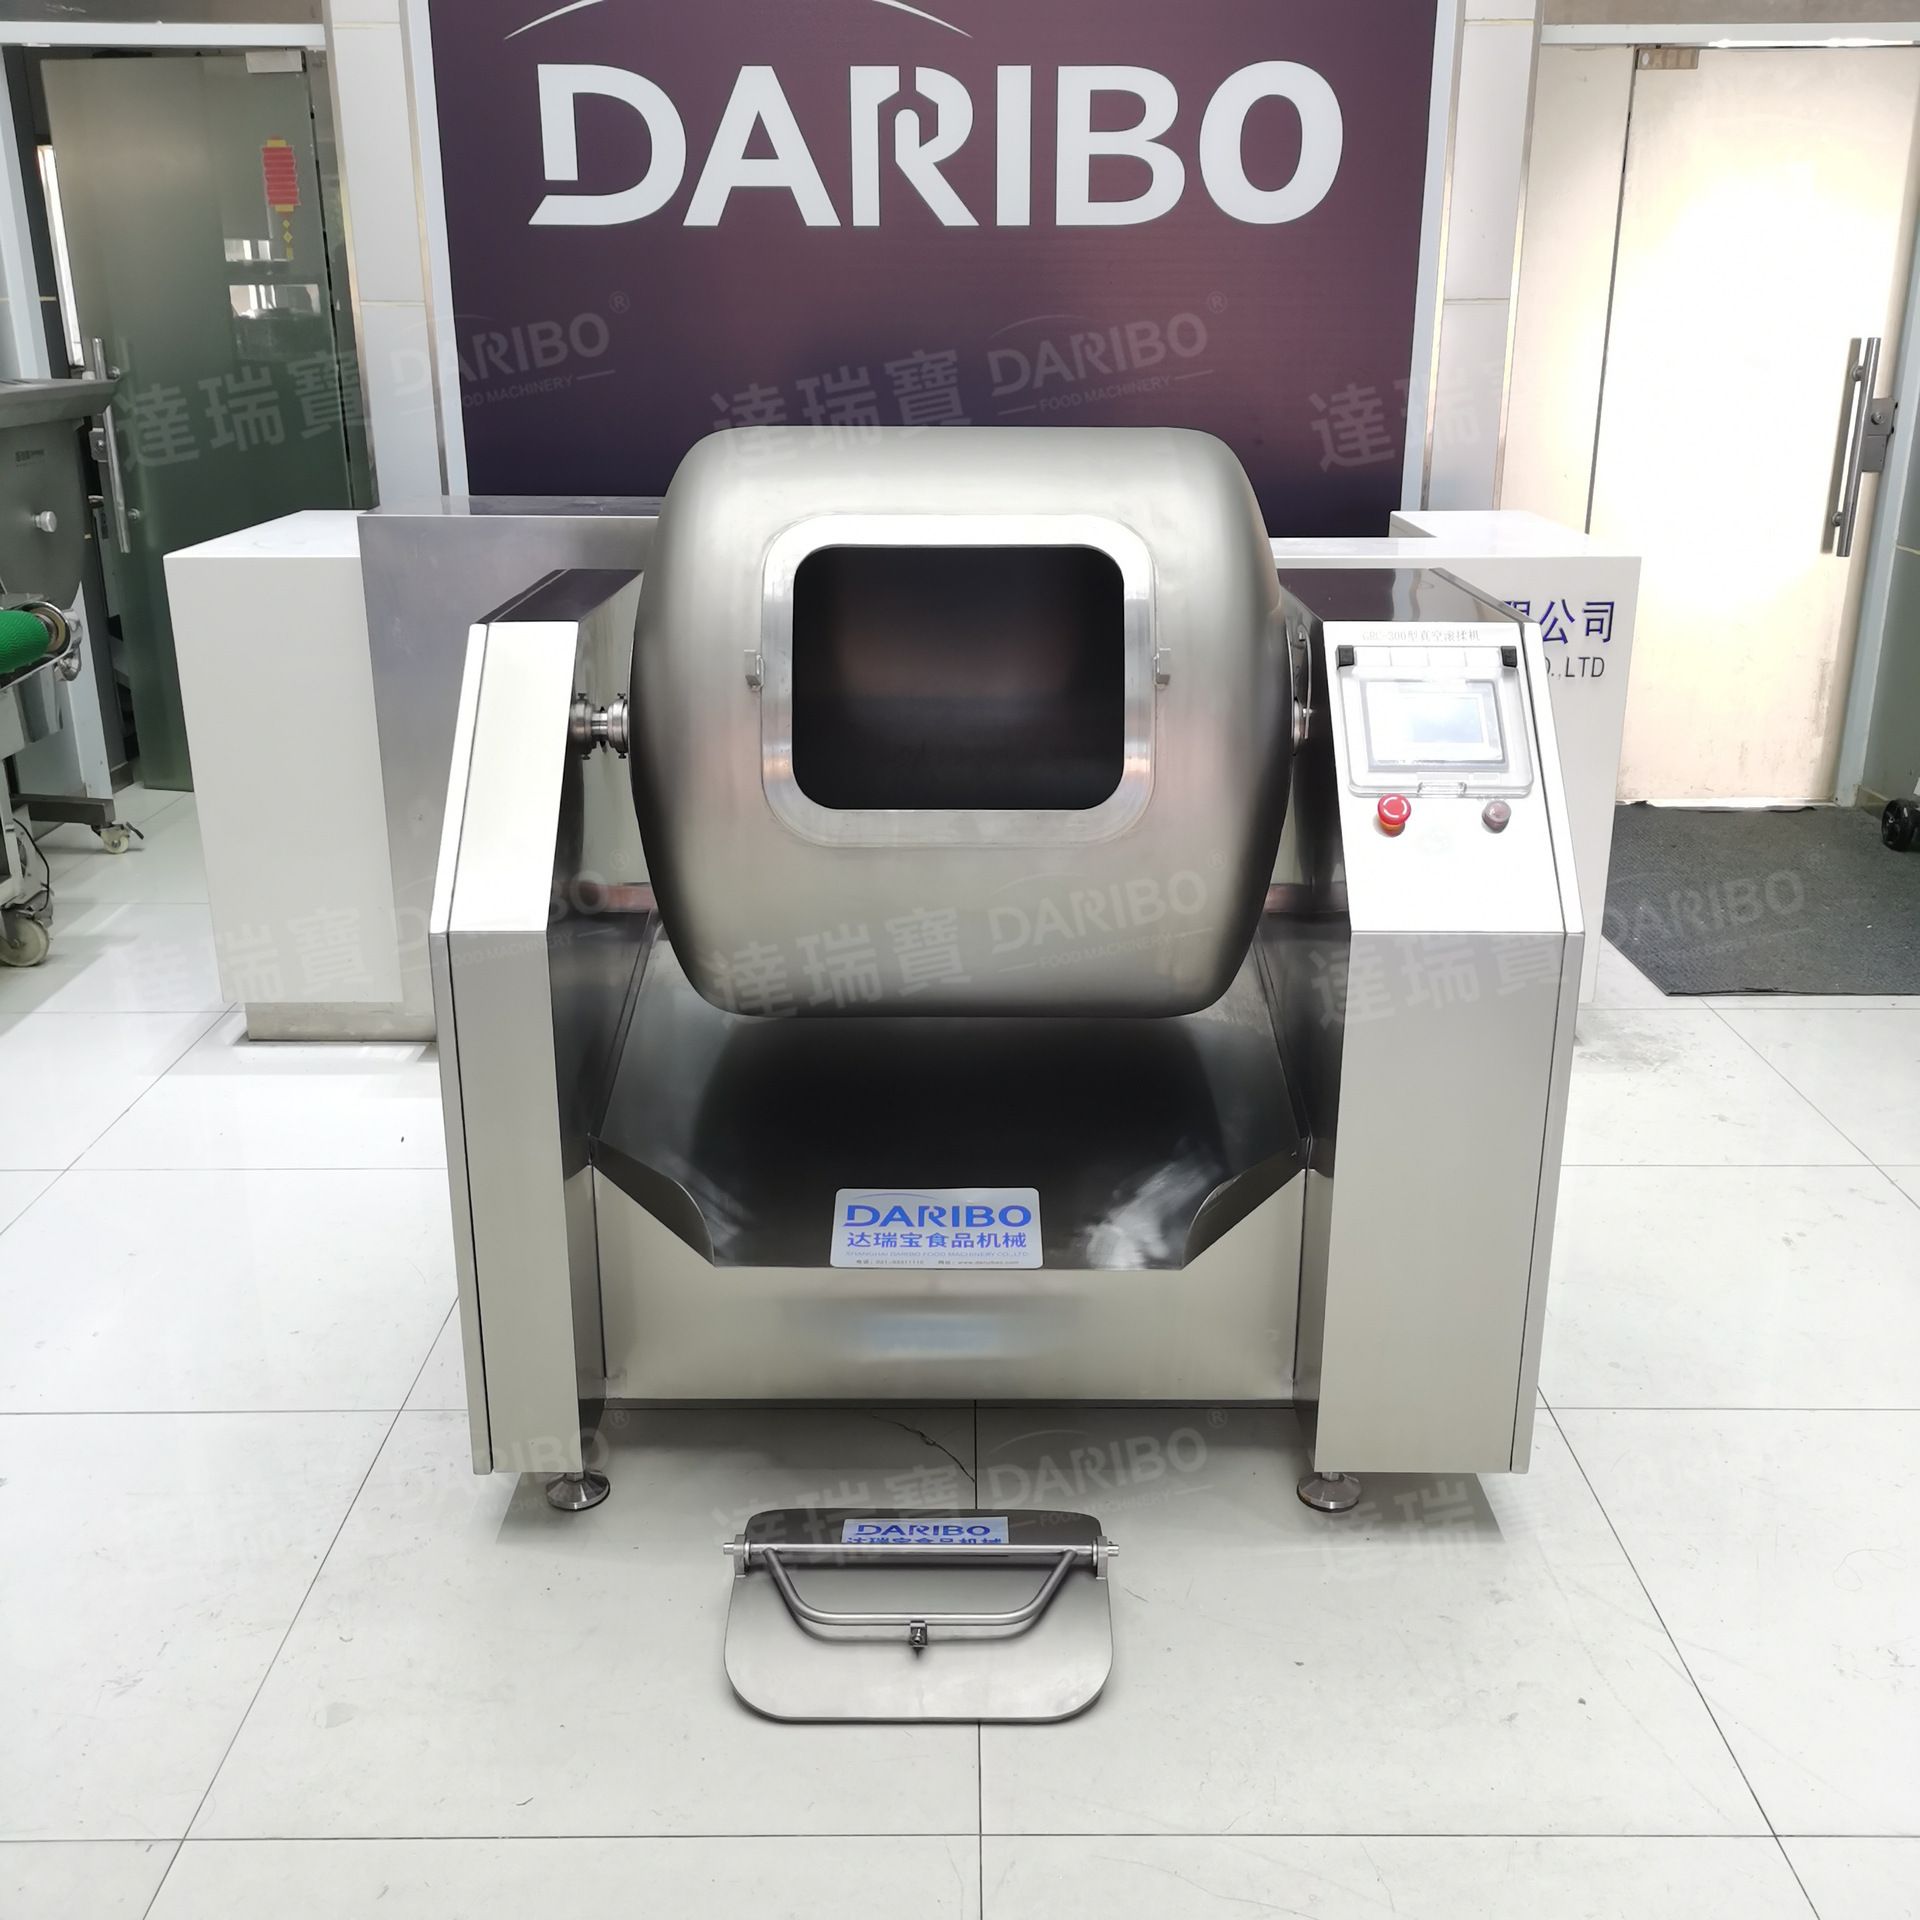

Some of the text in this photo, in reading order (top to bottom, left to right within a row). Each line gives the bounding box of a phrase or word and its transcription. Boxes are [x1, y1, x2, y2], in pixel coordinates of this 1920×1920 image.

[529, 60, 1343, 227] DARIBO
[844, 1205, 1032, 1227] DARIBO
[847, 1232, 1027, 1248] 达瑞宝食品机械
[856, 1525, 990, 1536] DARIBO
